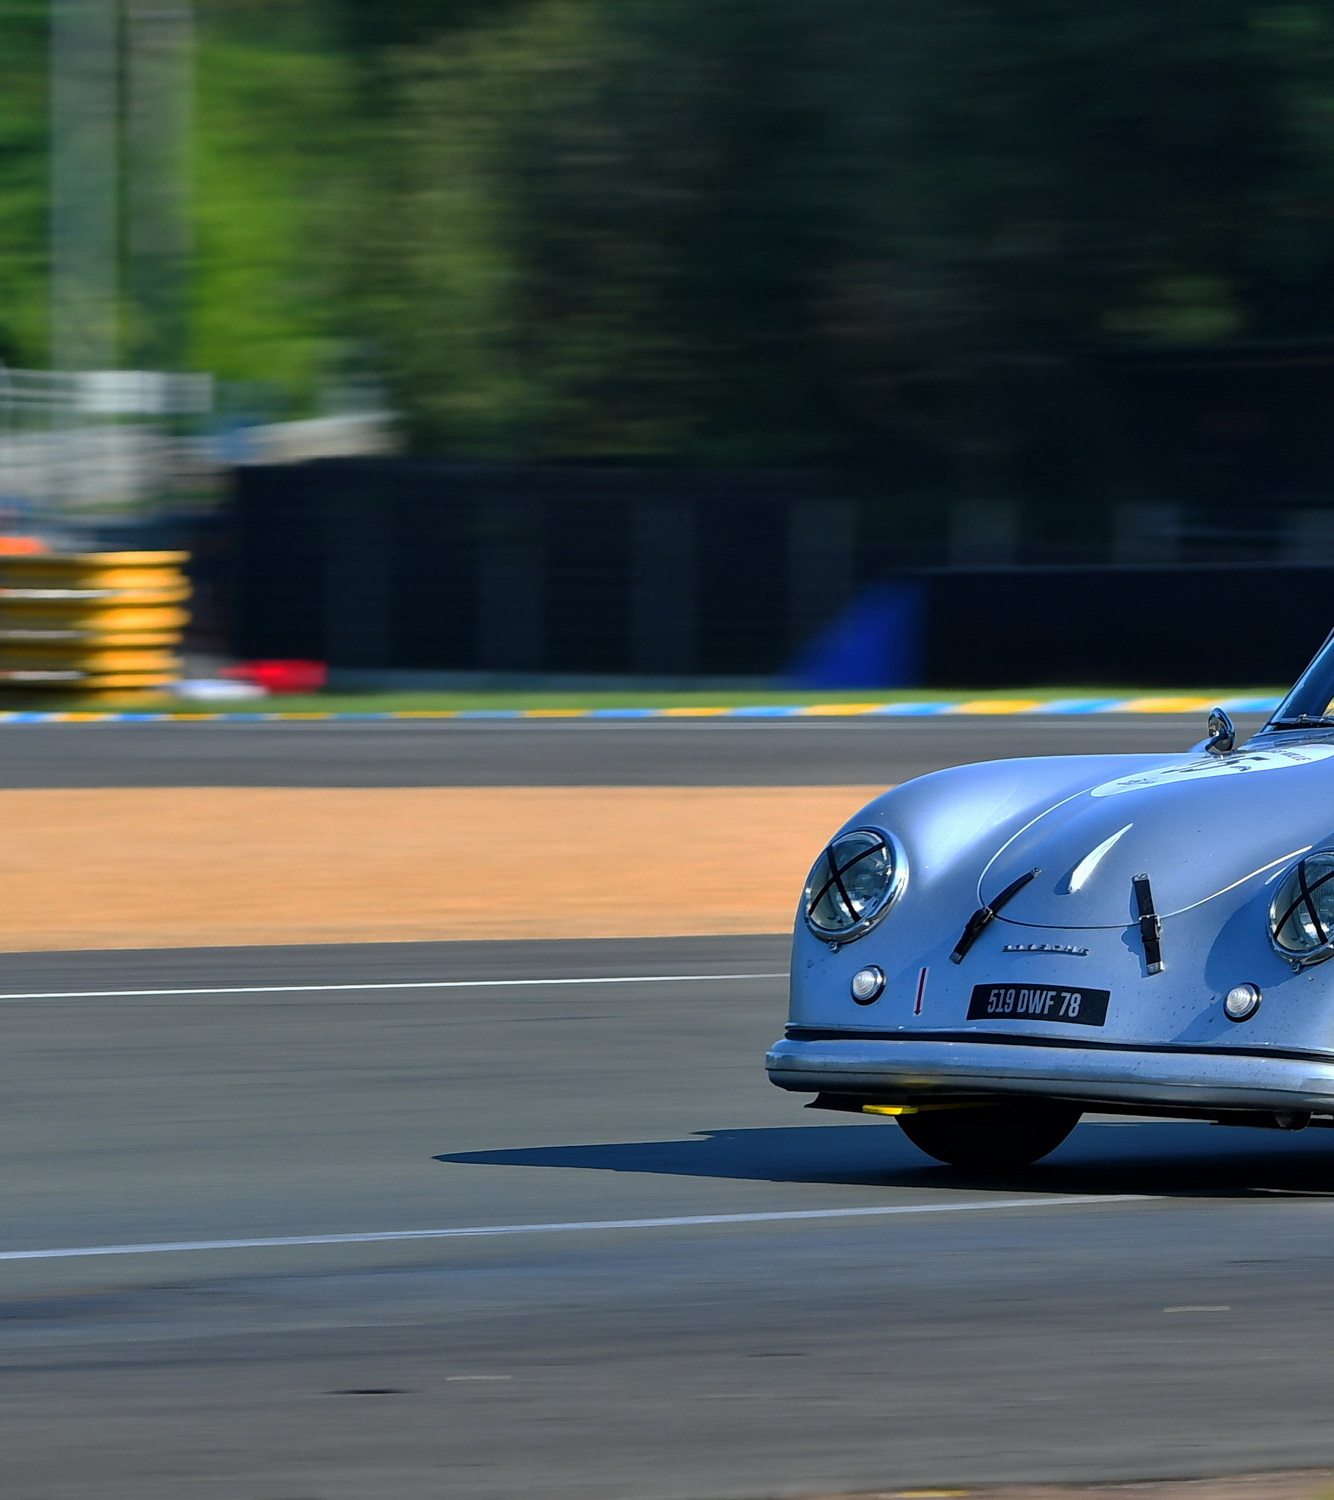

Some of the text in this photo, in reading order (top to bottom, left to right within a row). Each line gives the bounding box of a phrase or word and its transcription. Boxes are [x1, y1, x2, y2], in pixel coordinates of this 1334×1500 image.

[987, 989, 1082, 1018] 519 DWF 78
